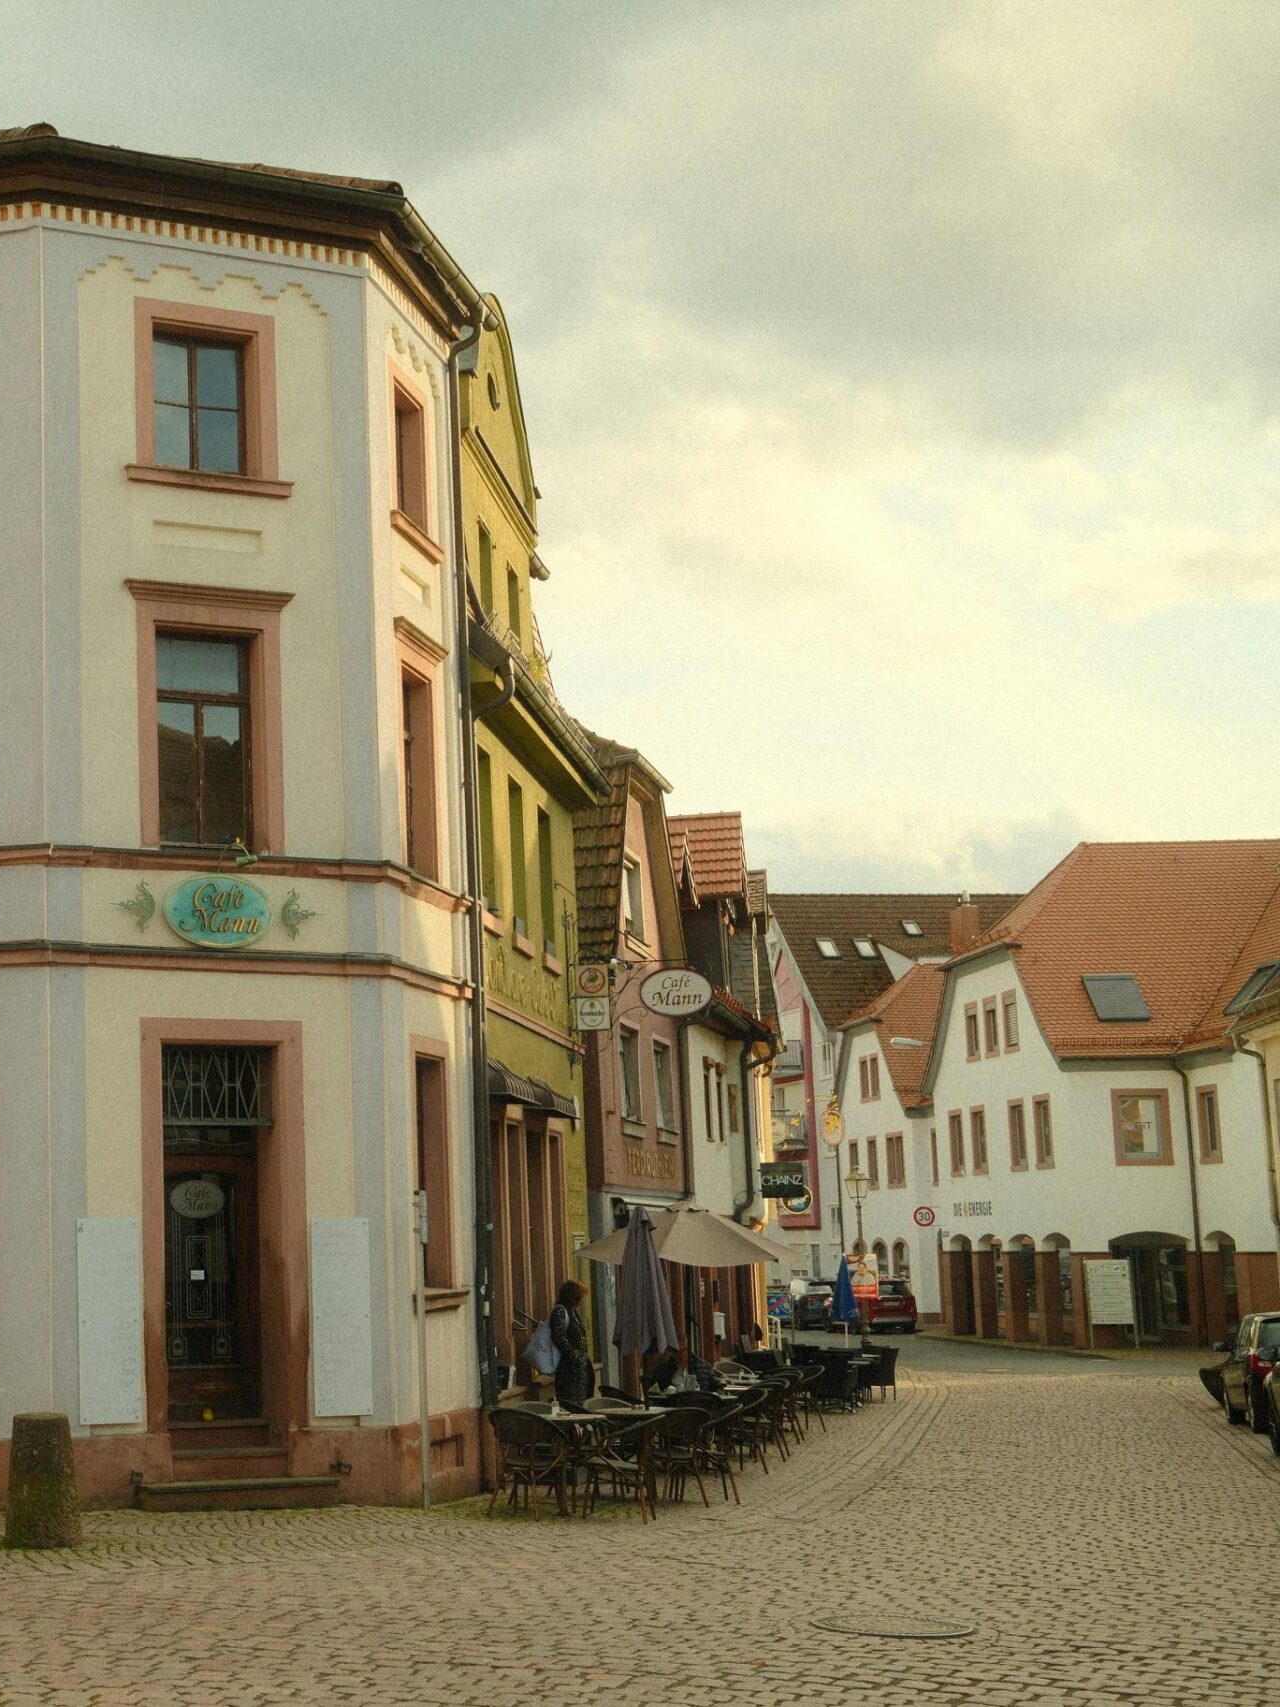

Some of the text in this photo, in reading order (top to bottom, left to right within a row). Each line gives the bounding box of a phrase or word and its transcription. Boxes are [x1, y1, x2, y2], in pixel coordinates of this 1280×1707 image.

[179, 907, 259, 934] Mann
[662, 973, 691, 992] Café
[651, 989, 703, 1007] Mann
[761, 1174, 803, 1186] CHAINZ
[918, 1211, 931, 1221] 30
